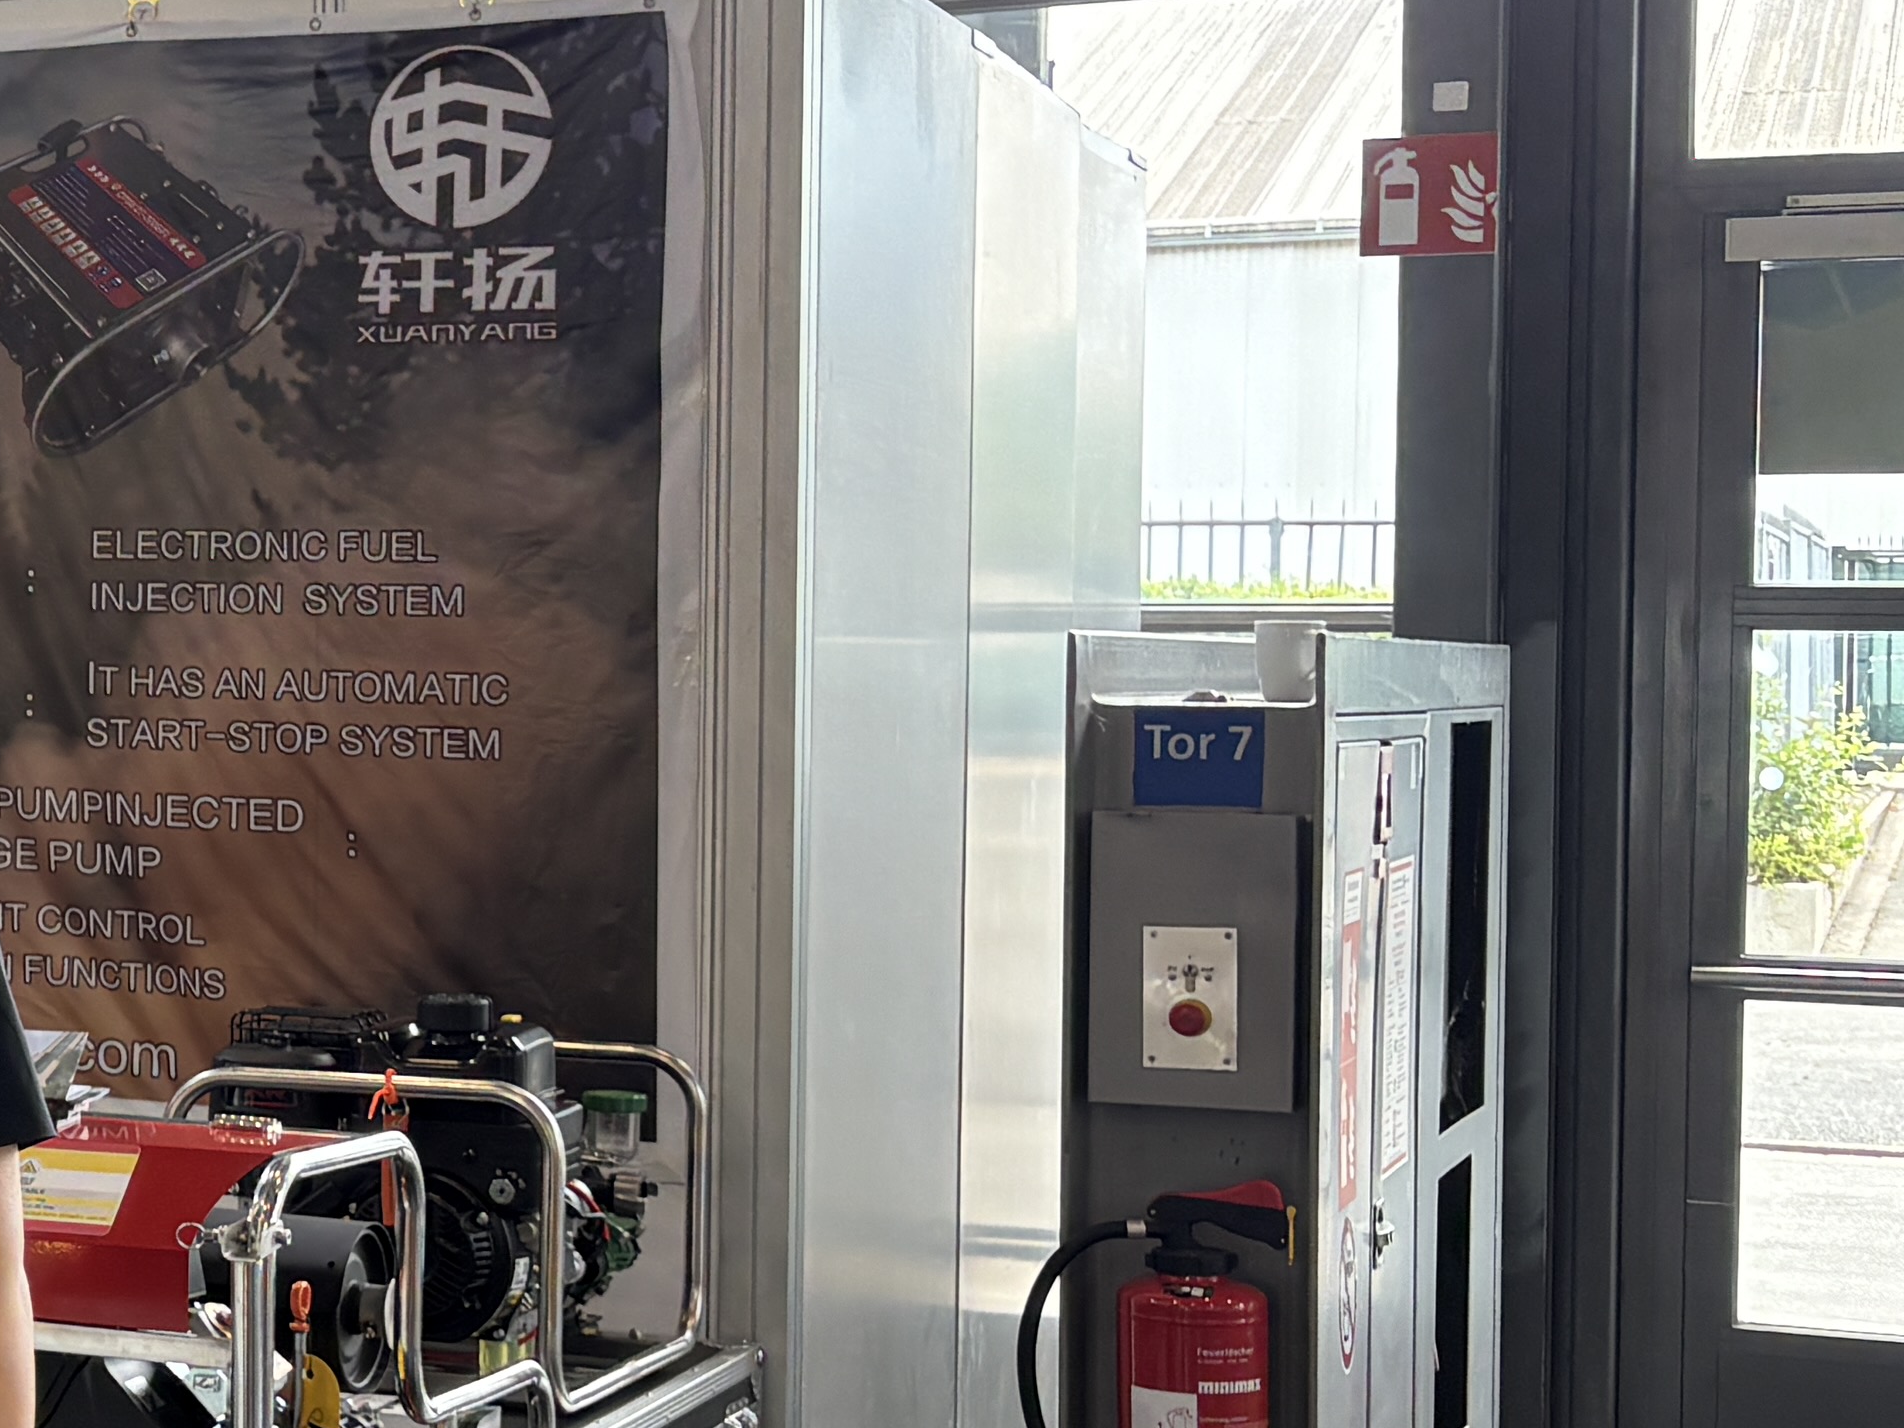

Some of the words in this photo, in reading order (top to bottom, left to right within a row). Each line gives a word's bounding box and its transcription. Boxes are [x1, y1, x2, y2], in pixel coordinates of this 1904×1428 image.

[357, 245, 556, 314] 轩扬
[357, 322, 556, 342] XUANYANG
[92, 529, 328, 562] ELECTRONIC
[338, 530, 439, 564] FUEL
[92, 581, 283, 616] INJECTION
[303, 584, 464, 618] SYSTEM
[87, 661, 119, 696] IT
[130, 665, 204, 699] HAS
[214, 667, 266, 702] AN
[274, 669, 508, 707] AUTOMATIC
[86, 718, 328, 756] START-STOP
[338, 723, 501, 761] SYSTEM
[1143, 724, 1216, 760] Tor
[1228, 726, 1253, 761] 7
[49, 841, 161, 878] PUMP
[37, 904, 206, 946] CONTROL
[24, 954, 226, 1000] FUNCTIONS
[1198, 1379, 1261, 1394] minimax
